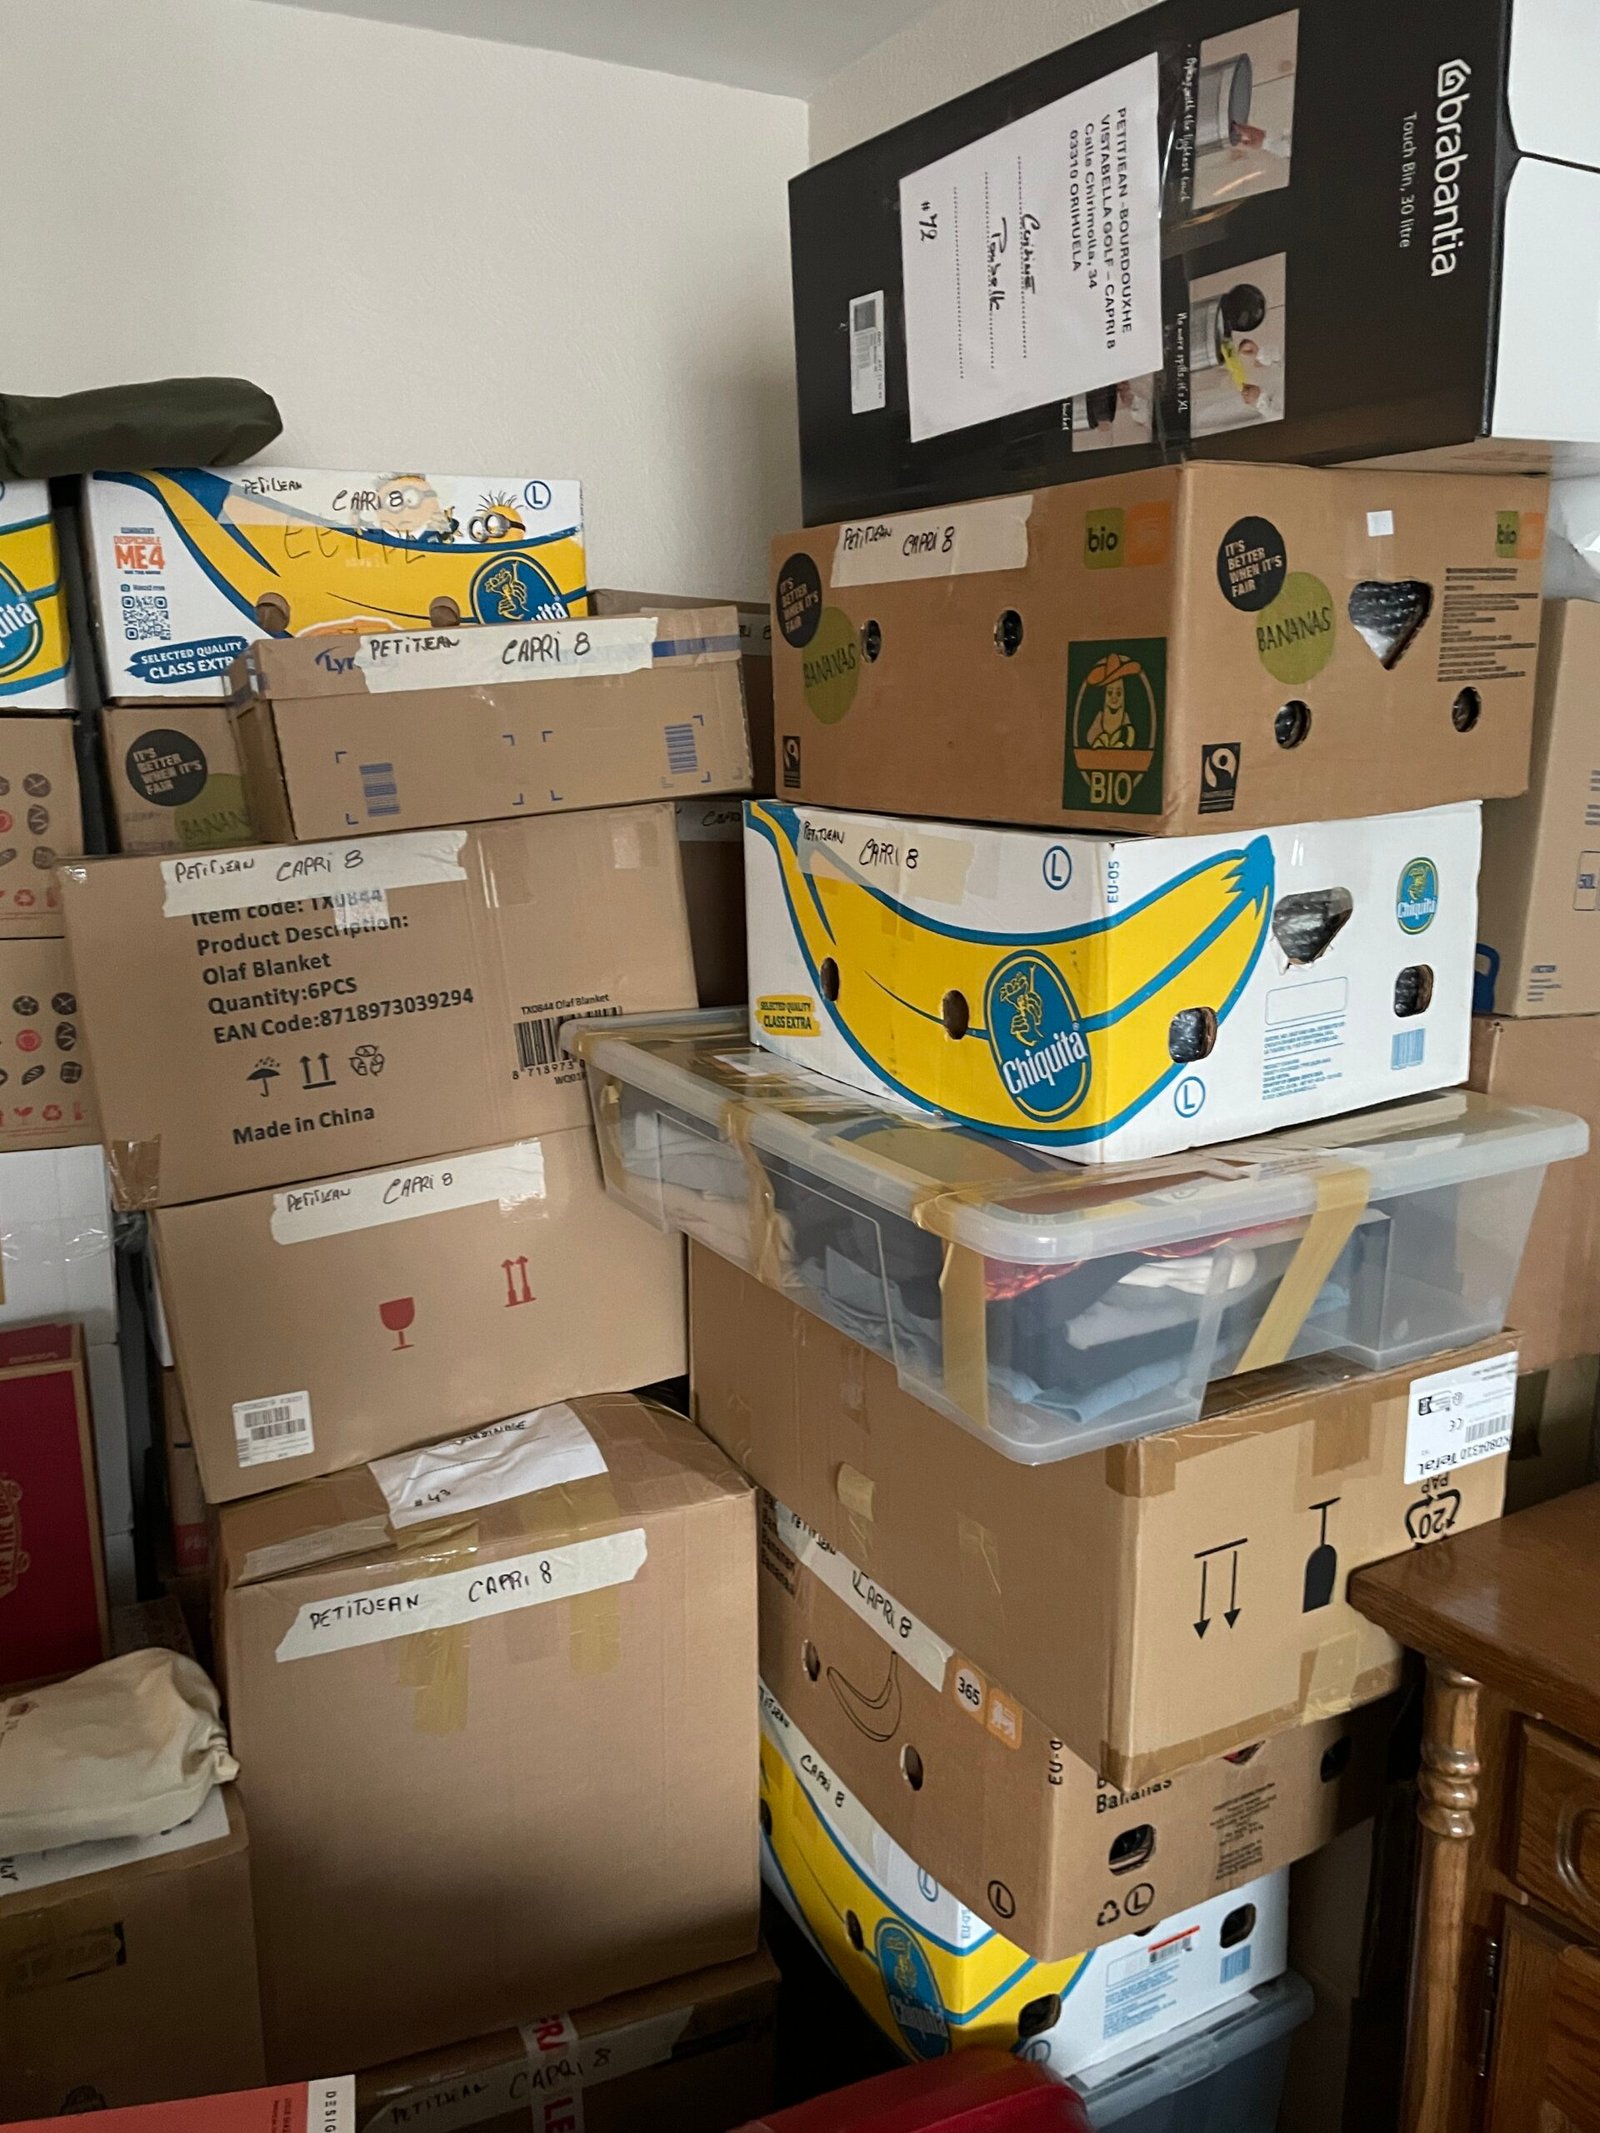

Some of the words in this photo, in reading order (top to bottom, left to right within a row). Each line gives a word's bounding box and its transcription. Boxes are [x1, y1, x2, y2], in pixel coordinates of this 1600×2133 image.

[1085, 122, 1095, 163] Calle
[1403, 111, 1418, 159] Touch
[1069, 129, 1079, 180] 03310
[1116, 106, 1128, 197] PETITJEAN
[1176, 134, 1193, 172] lightest
[1101, 114, 1112, 219] VISTABELLA
[1179, 177, 1191, 203] touch
[1431, 94, 1472, 278] brabantia
[1402, 194, 1415, 215] 30
[1070, 182, 1082, 273] ORIHUELA
[1399, 216, 1414, 249] litre
[1104, 220, 1113, 265] GOLF
[1088, 270, 1097, 291] 34
[1106, 283, 1116, 337] CAPRI
[388, 489, 404, 507] 8
[942, 526, 956, 553] 8
[1088, 528, 1118, 552] bio
[1497, 523, 1517, 545] bio
[1225, 540, 1245, 557] IT'S
[1227, 547, 1265, 571] BETTER
[1229, 564, 1260, 584] WHEN
[1262, 555, 1283, 573] IT'S
[1231, 579, 1256, 598] FAIR
[1256, 606, 1332, 653] BANANAS
[141, 648, 195, 664] SELECTED
[197, 641, 242, 657] QUALITY
[575, 632, 591, 656] 8
[150, 660, 196, 679] CLASS
[803, 643, 857, 688] BANANAS
[134, 747, 157, 761] IT'S
[137, 752, 183, 773] BETTER
[141, 766, 176, 785] WHEN
[178, 761, 203, 776] IT'S
[147, 777, 175, 795] FAIR
[1091, 771, 1132, 806] BIO
[344, 850, 364, 869] 8
[905, 848, 919, 869] 8
[1107, 860, 1120, 904] EU-05
[247, 897, 304, 920] code:
[197, 929, 280, 956] Product
[286, 911, 410, 942] Description:
[203, 961, 247, 986] Olaf
[253, 951, 332, 978] Blanket
[208, 977, 358, 1015] Quantity:6PCS
[760, 1000, 787, 1013] SELECTED
[787, 1001, 812, 1015] QUALITY
[214, 1022, 257, 1045] EAN
[262, 988, 474, 1034] Code:8718973039294
[763, 1015, 785, 1029] CLASS
[786, 1016, 812, 1031] EXTRA
[1003, 1031, 1087, 1095] Chiquita
[233, 1125, 291, 1146] Made
[295, 1119, 315, 1133] in
[320, 1105, 375, 1128] China
[442, 1173, 454, 1187] 8
[1415, 1449, 1459, 1475] Tefal
[1420, 1507, 1446, 1538] 20
[540, 1561, 553, 1585] 8
[898, 1616, 914, 1640] 8
[957, 1675, 981, 1706] 365
[834, 1791, 846, 1808] 8
[594, 2047, 611, 2067] 8
